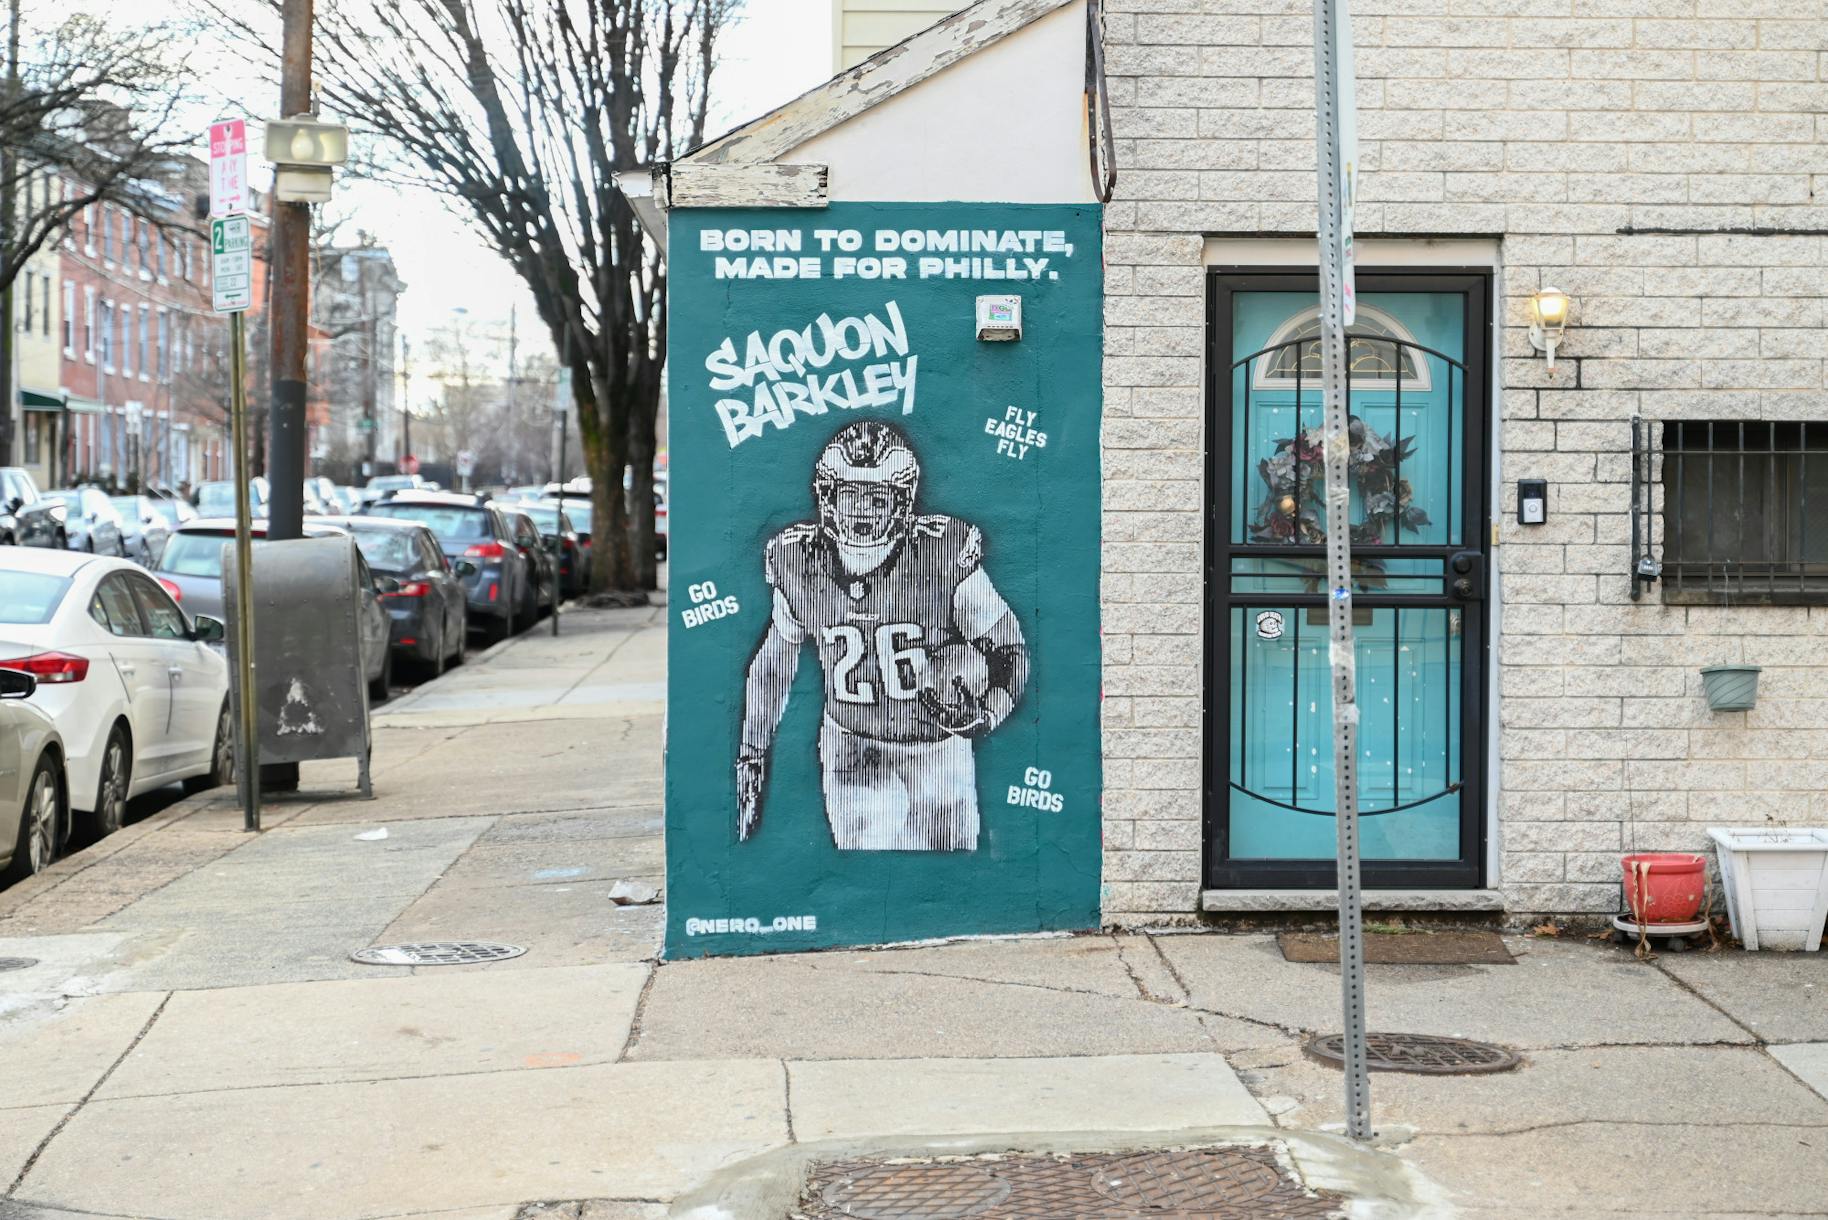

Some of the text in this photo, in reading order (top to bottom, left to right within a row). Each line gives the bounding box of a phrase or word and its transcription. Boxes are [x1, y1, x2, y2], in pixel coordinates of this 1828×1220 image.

[214, 226, 223, 251] 2
[700, 229, 1073, 257] BORN TO DOMINATE,
[715, 256, 1059, 280] MADE FOR PHILLY.
[704, 300, 909, 390] SAQUON
[715, 354, 918, 449] BARKLEY
[1005, 405, 1037, 427] FLY
[984, 417, 1048, 448] EAGLES
[996, 438, 1029, 460] FLY
[688, 580, 717, 603] GO
[681, 595, 740, 629] BIRDS
[821, 622, 929, 704] 26
[1024, 766, 1052, 789] GO
[1006, 785, 1064, 813] BIRDS
[685, 915, 817, 937] @NERO_ONE
